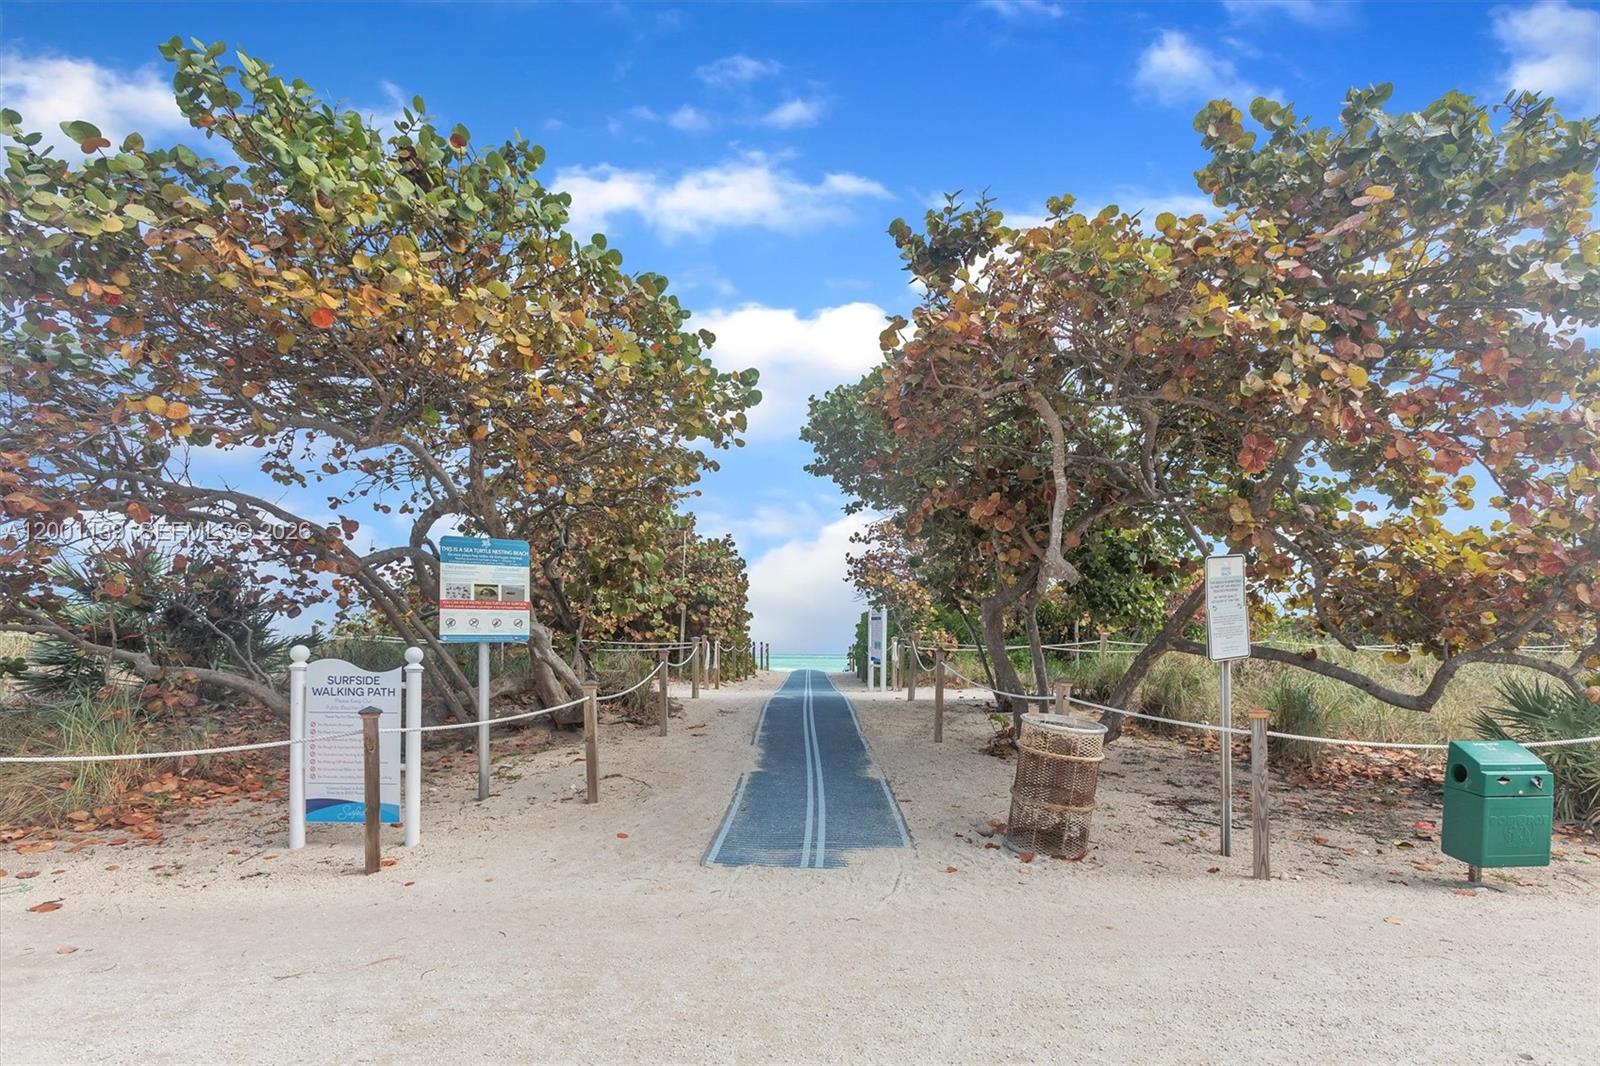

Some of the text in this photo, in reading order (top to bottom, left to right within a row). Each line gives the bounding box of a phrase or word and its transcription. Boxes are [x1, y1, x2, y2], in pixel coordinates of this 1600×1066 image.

[327, 675, 381, 686] SURFSIDE
[311, 687, 396, 697] WALKING PATH
